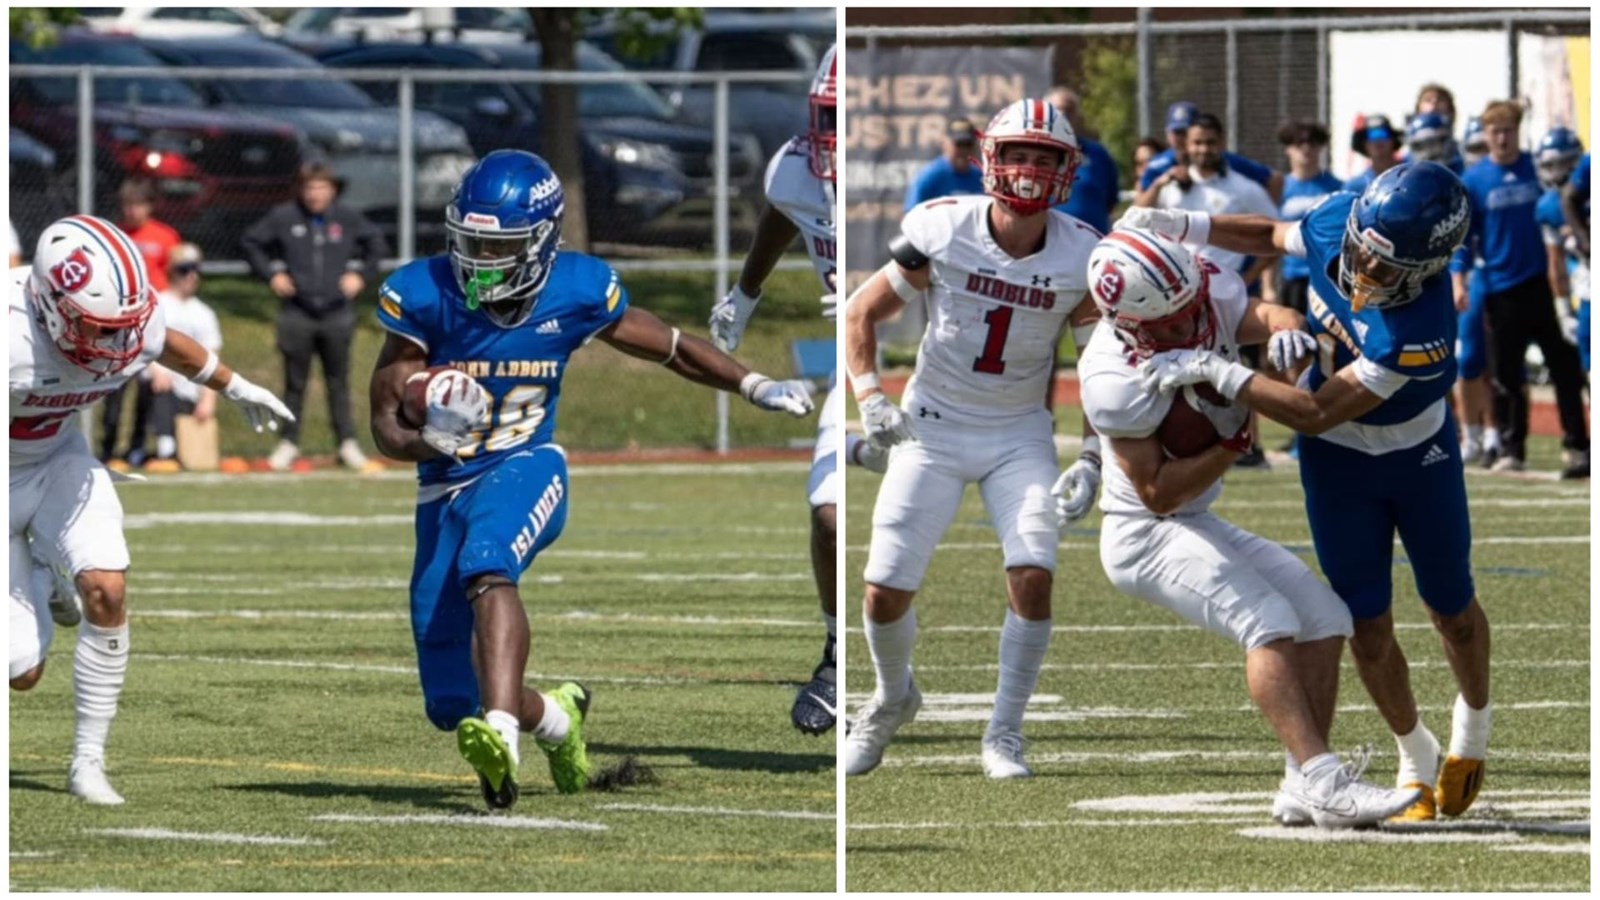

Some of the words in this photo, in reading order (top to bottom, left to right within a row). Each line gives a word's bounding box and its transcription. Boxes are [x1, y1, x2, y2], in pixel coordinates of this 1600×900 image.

[959, 74, 1024, 108] UN
[973, 304, 1015, 375] 1
[449, 361, 490, 378] OHN
[494, 360, 558, 378] ABBOTT
